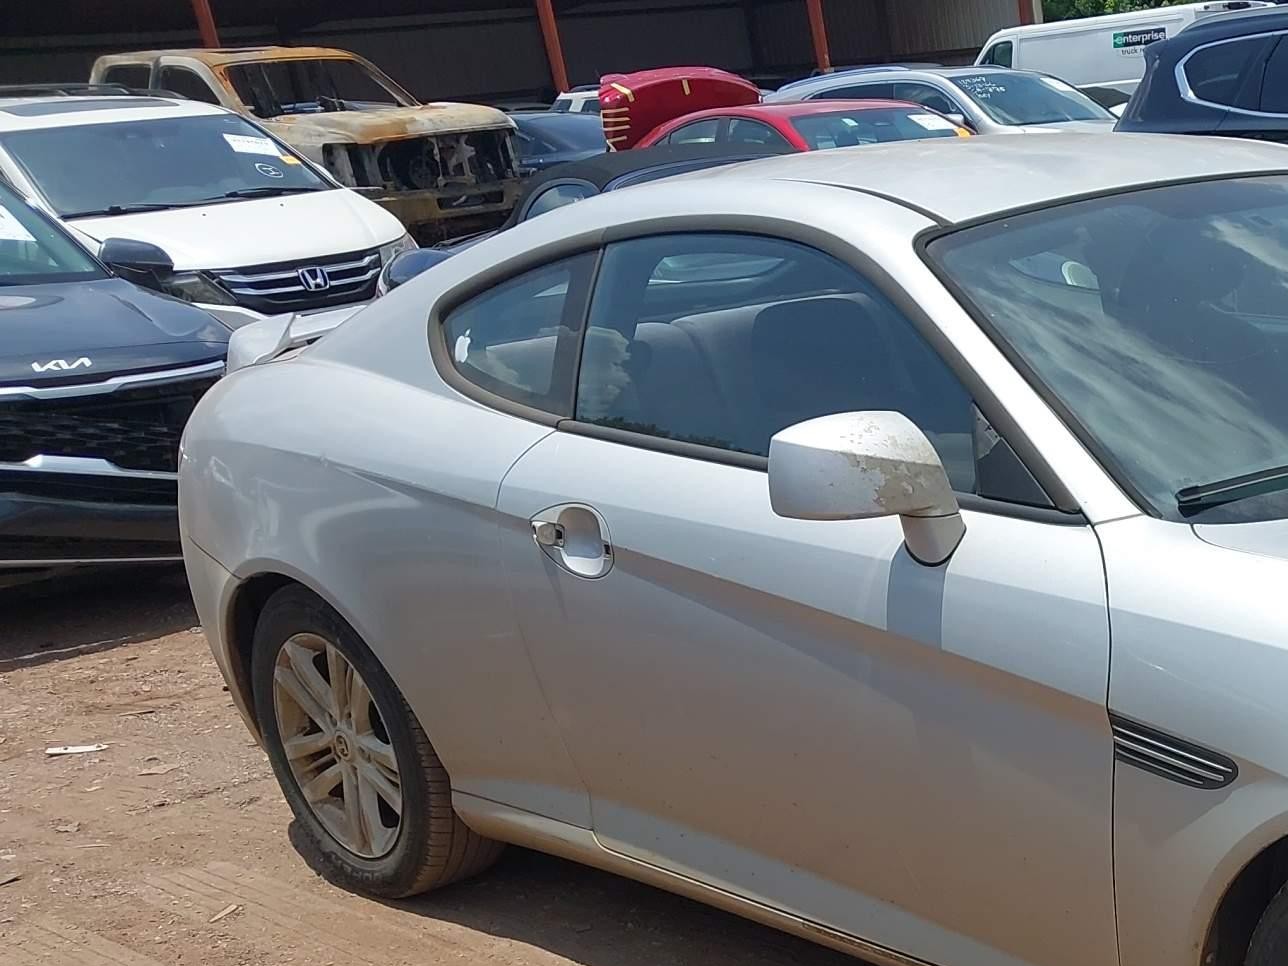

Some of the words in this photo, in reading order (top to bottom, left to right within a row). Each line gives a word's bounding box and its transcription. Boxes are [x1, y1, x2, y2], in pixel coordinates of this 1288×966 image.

[1114, 31, 1165, 45] enterprise
[1121, 47, 1138, 56] truck
[31, 357, 93, 373] KIA
